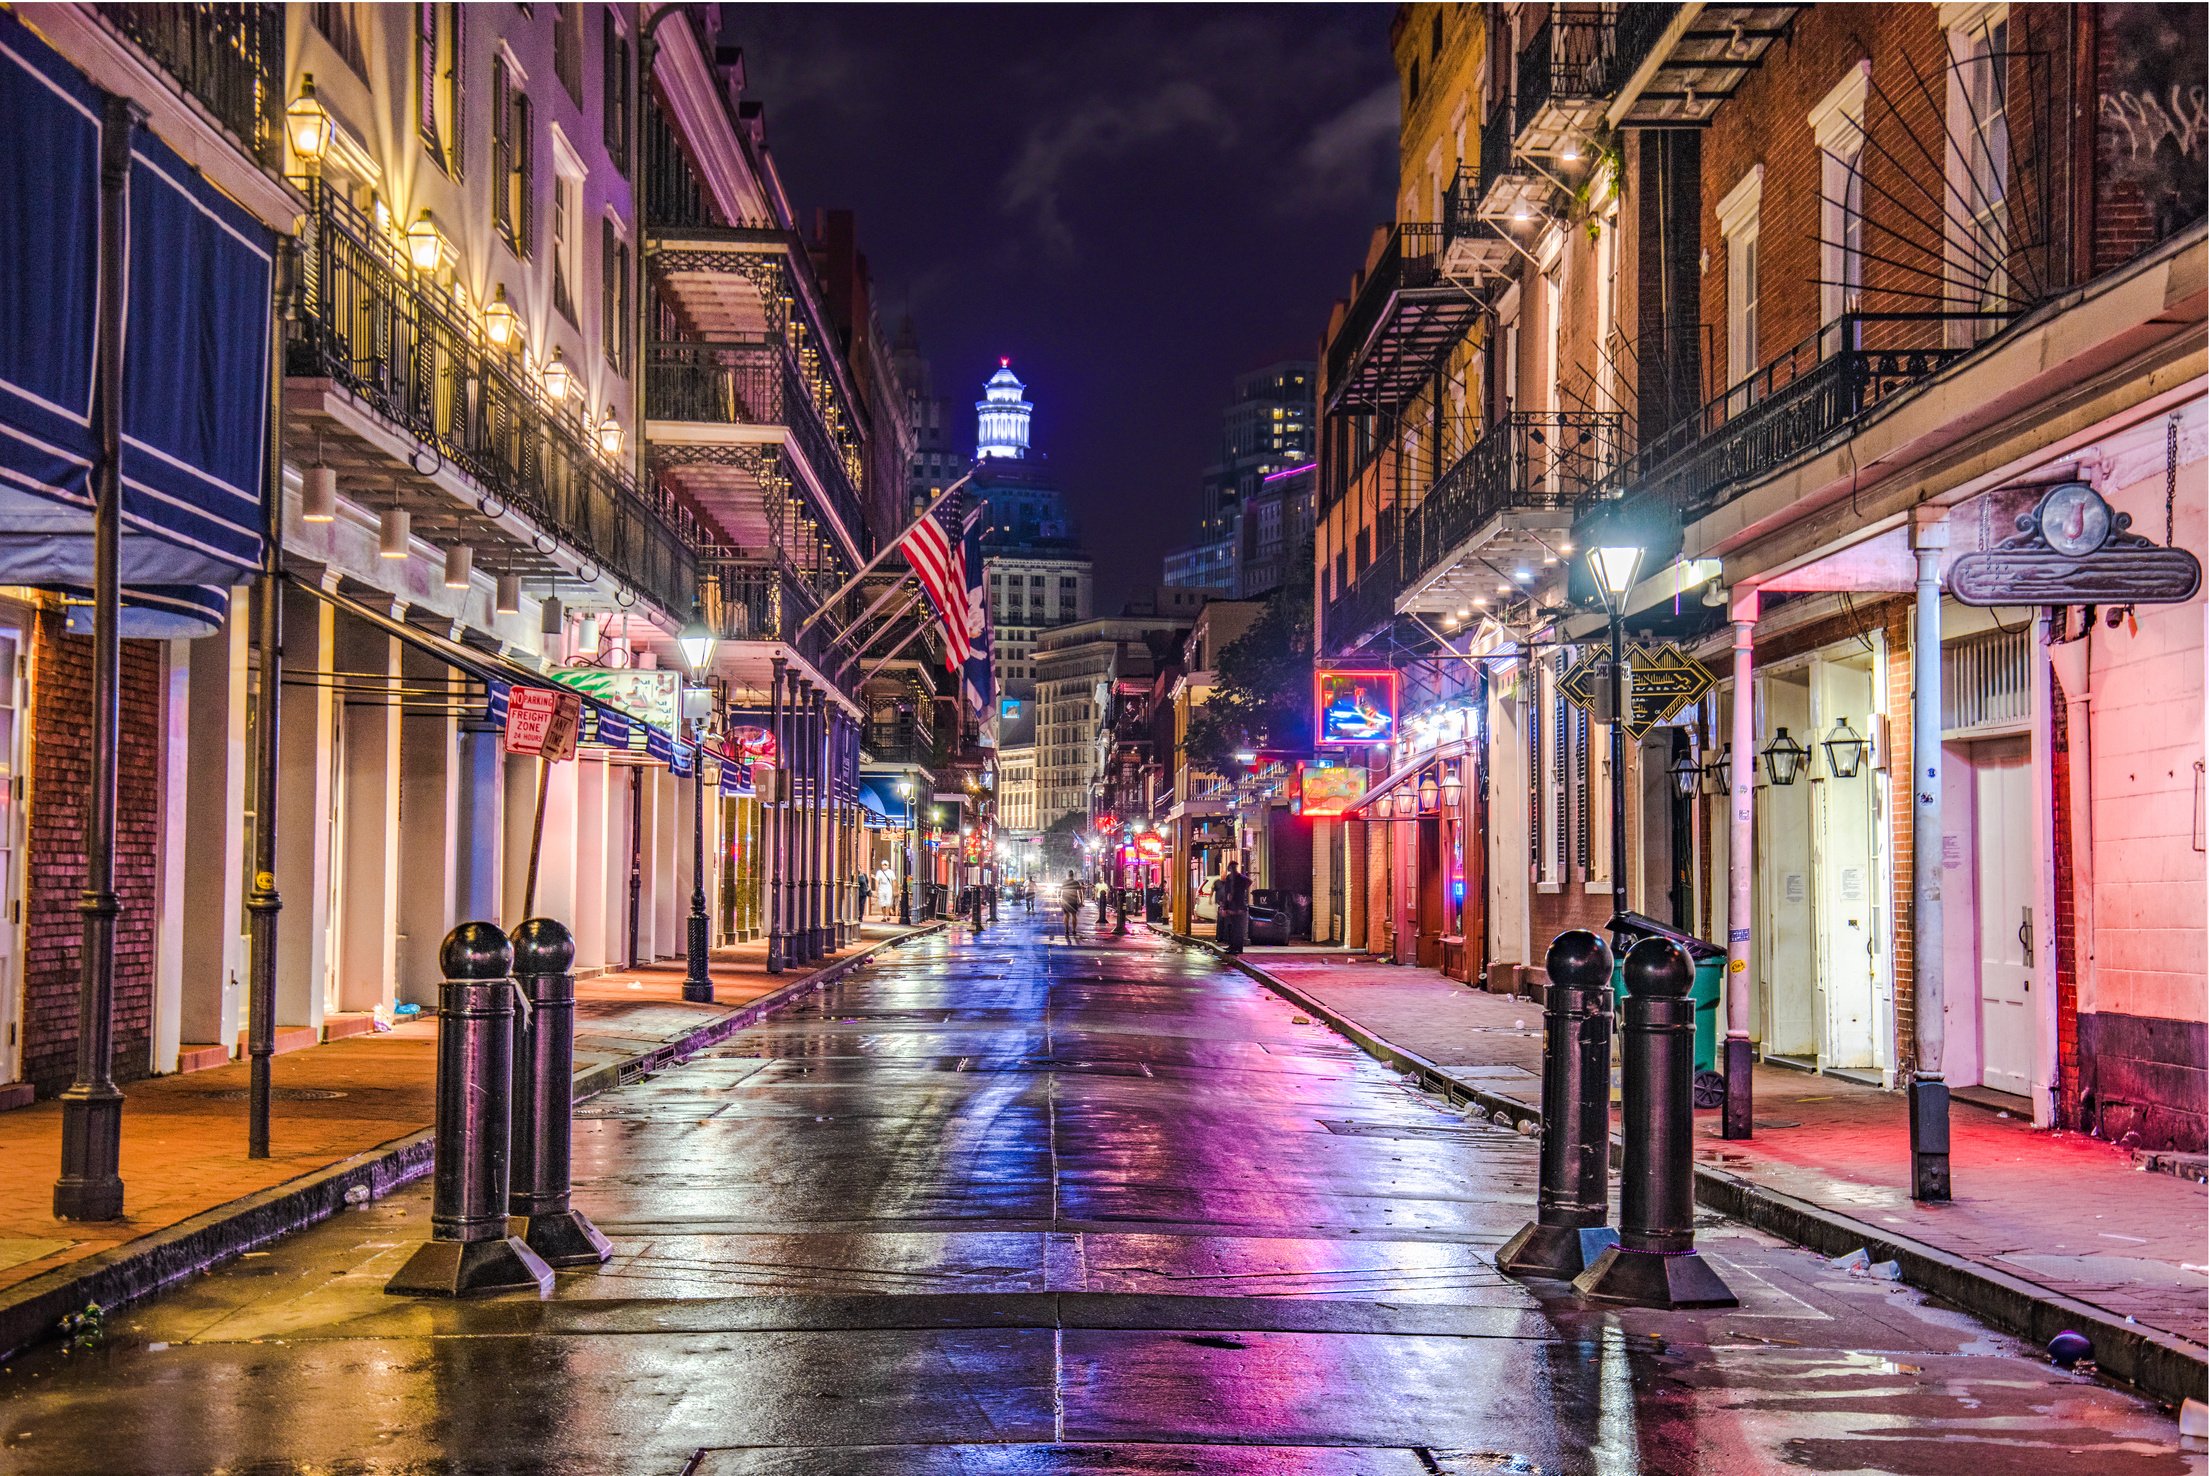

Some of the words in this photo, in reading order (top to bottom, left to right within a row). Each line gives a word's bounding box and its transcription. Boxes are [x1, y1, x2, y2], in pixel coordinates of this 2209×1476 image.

[510, 692, 524, 705] NO
[523, 695, 553, 707] PARKING
[511, 710, 549, 723] FREIGHT
[516, 721, 541, 732] ZONE
[554, 718, 568, 733] ANY
[523, 734, 543, 742] HOURS
[549, 731, 564, 746] TIME
